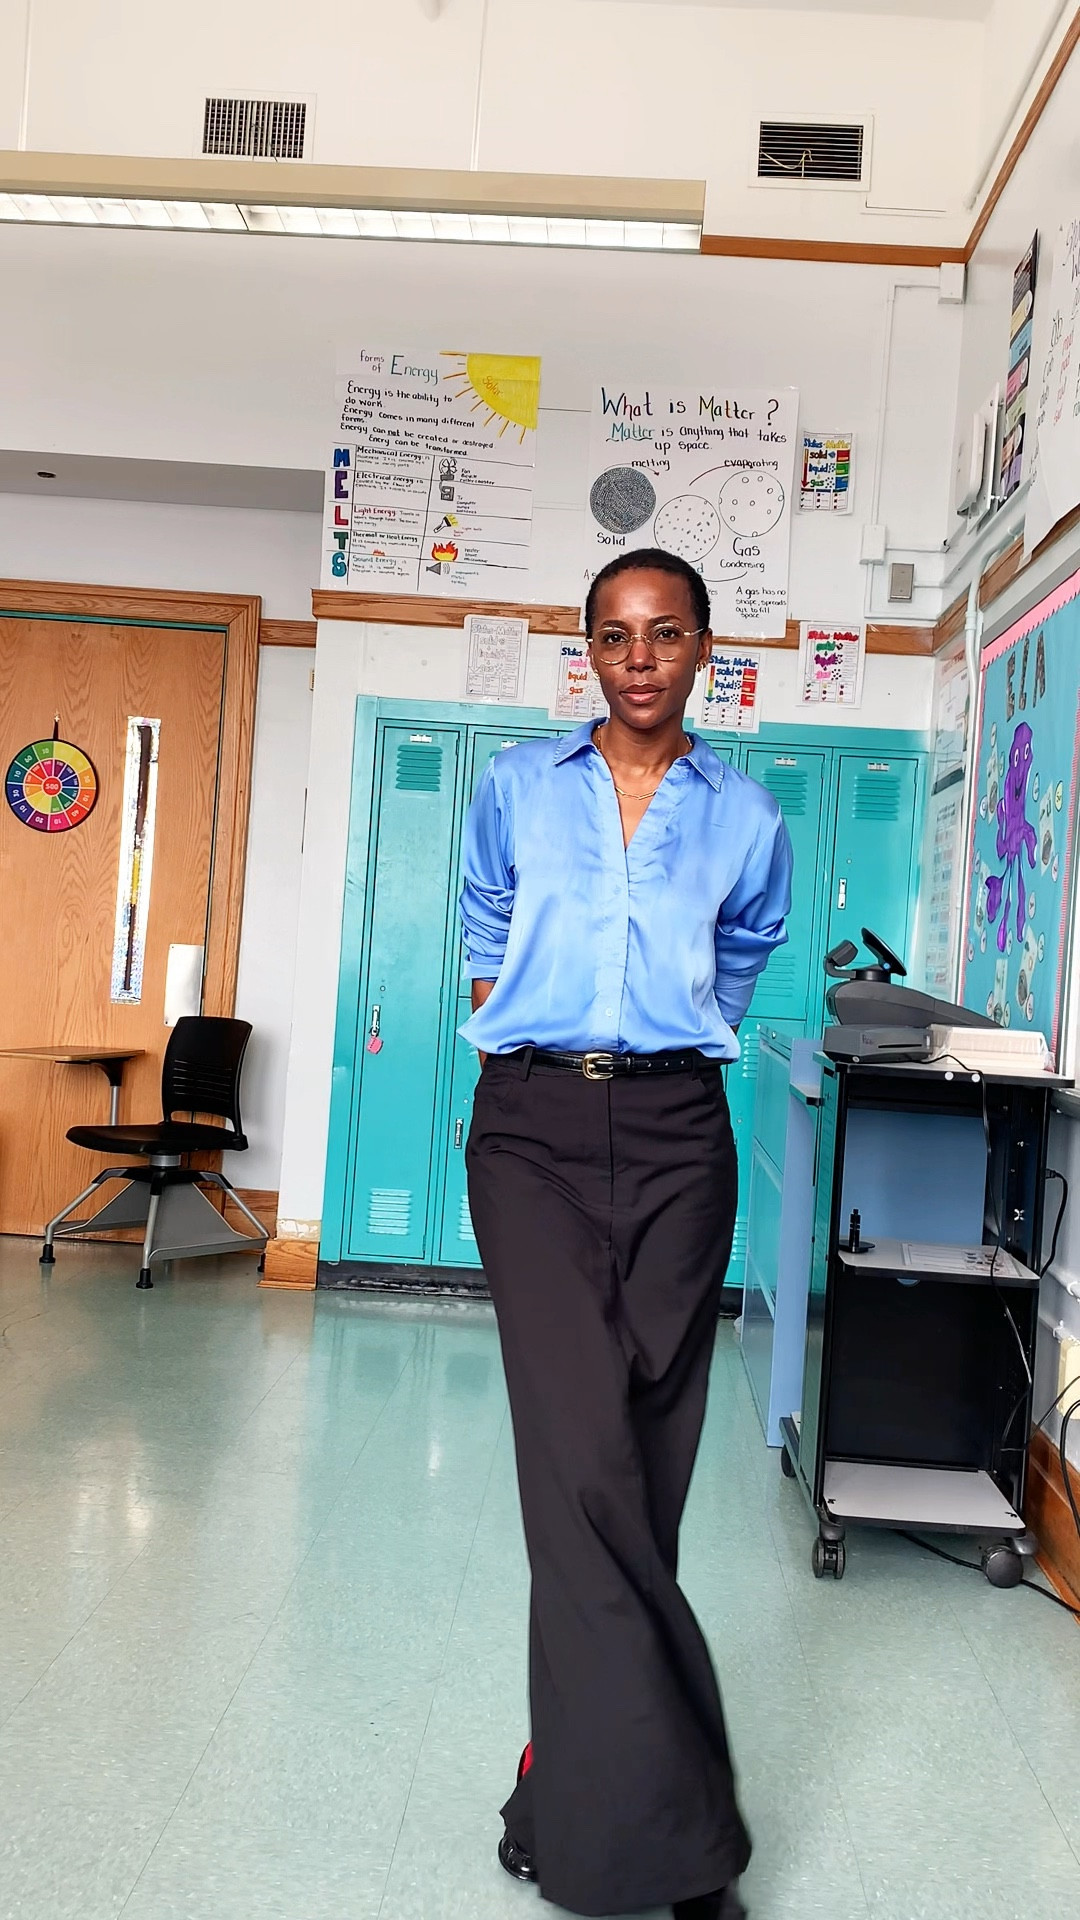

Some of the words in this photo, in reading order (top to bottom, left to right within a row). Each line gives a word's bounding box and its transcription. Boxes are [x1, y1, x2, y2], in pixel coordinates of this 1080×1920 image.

[360, 350, 385, 362] forms
[372, 363, 382, 373] of
[390, 355, 439, 386] Energy
[347, 380, 381, 399] Energy
[384, 389, 394, 397] is
[397, 388, 411, 399] the
[411, 392, 439, 407] ability
[444, 393, 453, 403] to
[345, 397, 356, 405] do
[601, 387, 653, 421] What
[669, 398, 686, 414] is
[699, 395, 755, 422] Matter
[344, 405, 373, 418] Energy
[378, 412, 403, 421] comes
[405, 415, 415, 423] in
[416, 418, 439, 427] many
[441, 417, 475, 428] different
[340, 422, 368, 434] Energy
[372, 427, 386, 435] can
[387, 429, 401, 437] not
[404, 430, 415, 438] be
[418, 433, 448, 443] created
[611, 422, 654, 440] Matter
[661, 426, 674, 437] is
[679, 426, 725, 441] anything
[728, 425, 749, 438] that
[757, 430, 787, 443] takes
[395, 438, 409, 447] can
[410, 439, 420, 447] be
[654, 442, 671, 455] up
[357, 446, 397, 457] Mechanical
[809, 450, 828, 459] solid
[631, 459, 670, 471] melting
[809, 463, 829, 475] liquid
[356, 472, 391, 480] Electrical
[810, 479, 825, 488] gas
[354, 505, 371, 515] Light
[373, 508, 396, 517] Energy
[596, 532, 626, 546] Solid
[733, 537, 760, 556] Gas
[720, 559, 765, 573] Condensing
[736, 586, 743, 595] A
[745, 588, 760, 599] gas
[762, 587, 776, 595] has
[716, 666, 734, 676] solid
[715, 680, 734, 691] liquid
[716, 695, 730, 703] gas
